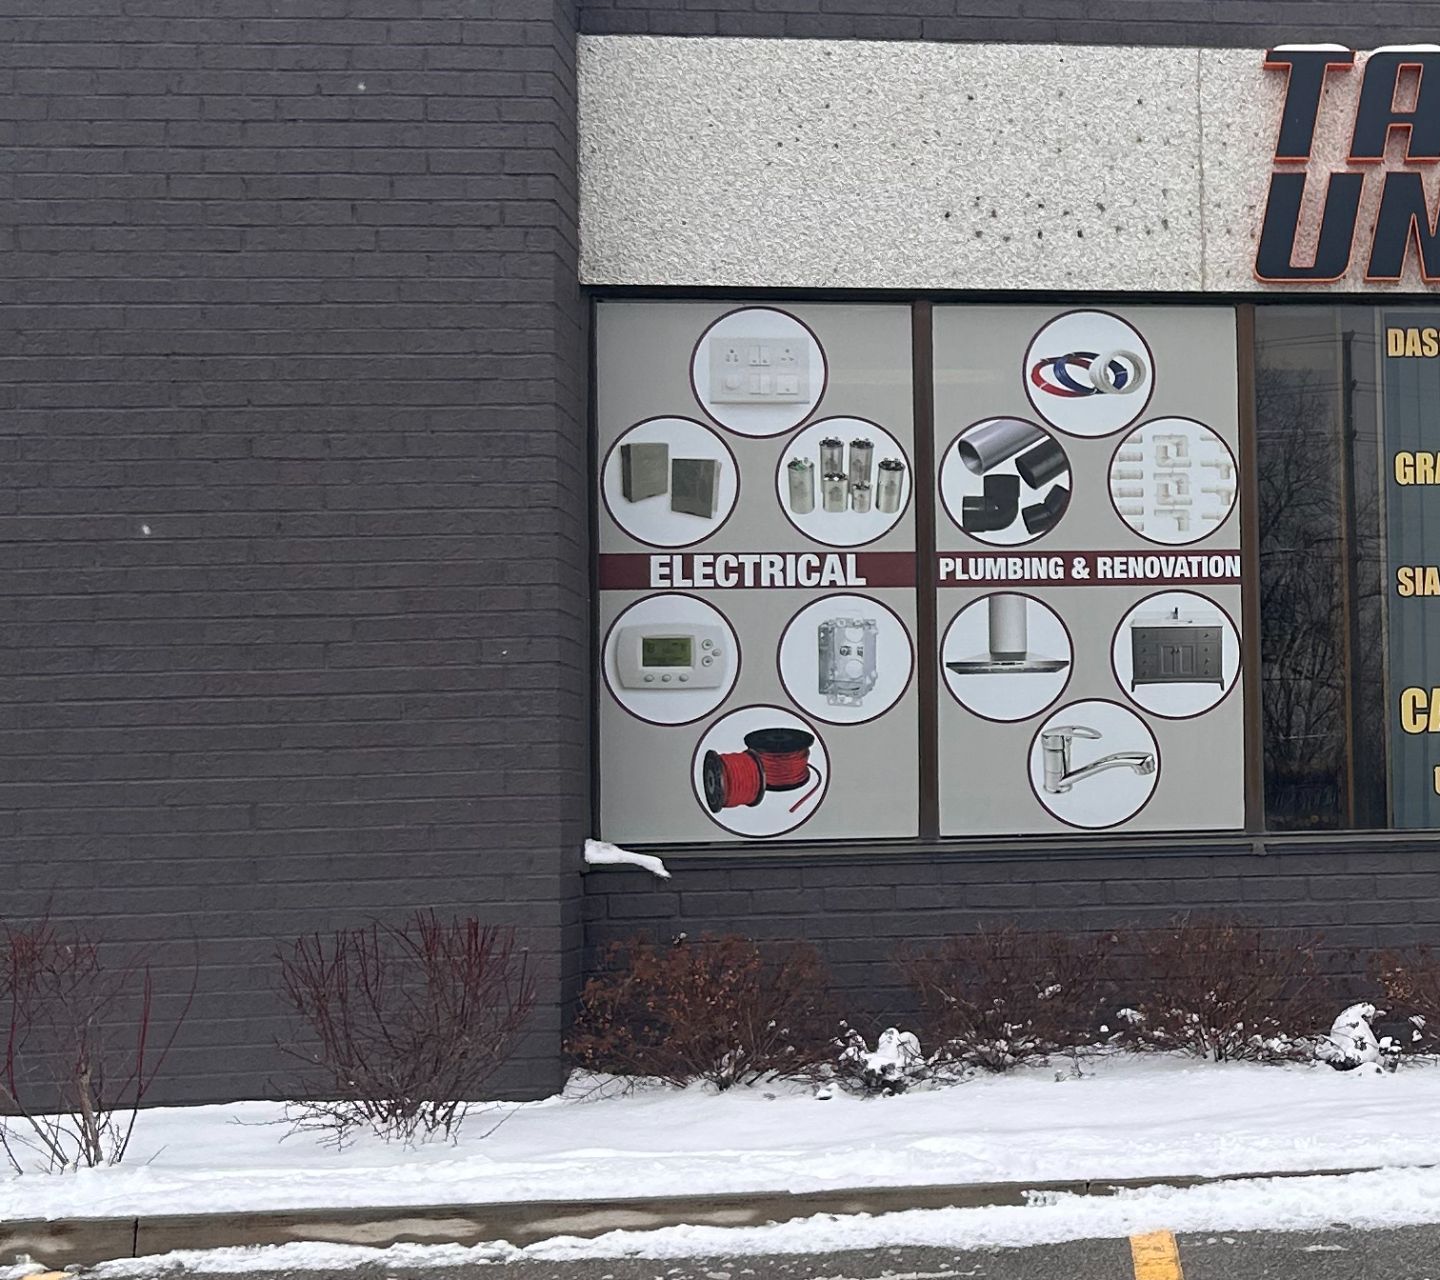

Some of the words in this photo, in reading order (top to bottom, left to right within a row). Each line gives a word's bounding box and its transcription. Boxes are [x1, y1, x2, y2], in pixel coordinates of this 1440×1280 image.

[650, 553, 867, 588] ELECTRICAL
[939, 556, 1064, 581] PLUMBING
[1071, 555, 1091, 580] &
[1096, 554, 1241, 580] RENOVATION
